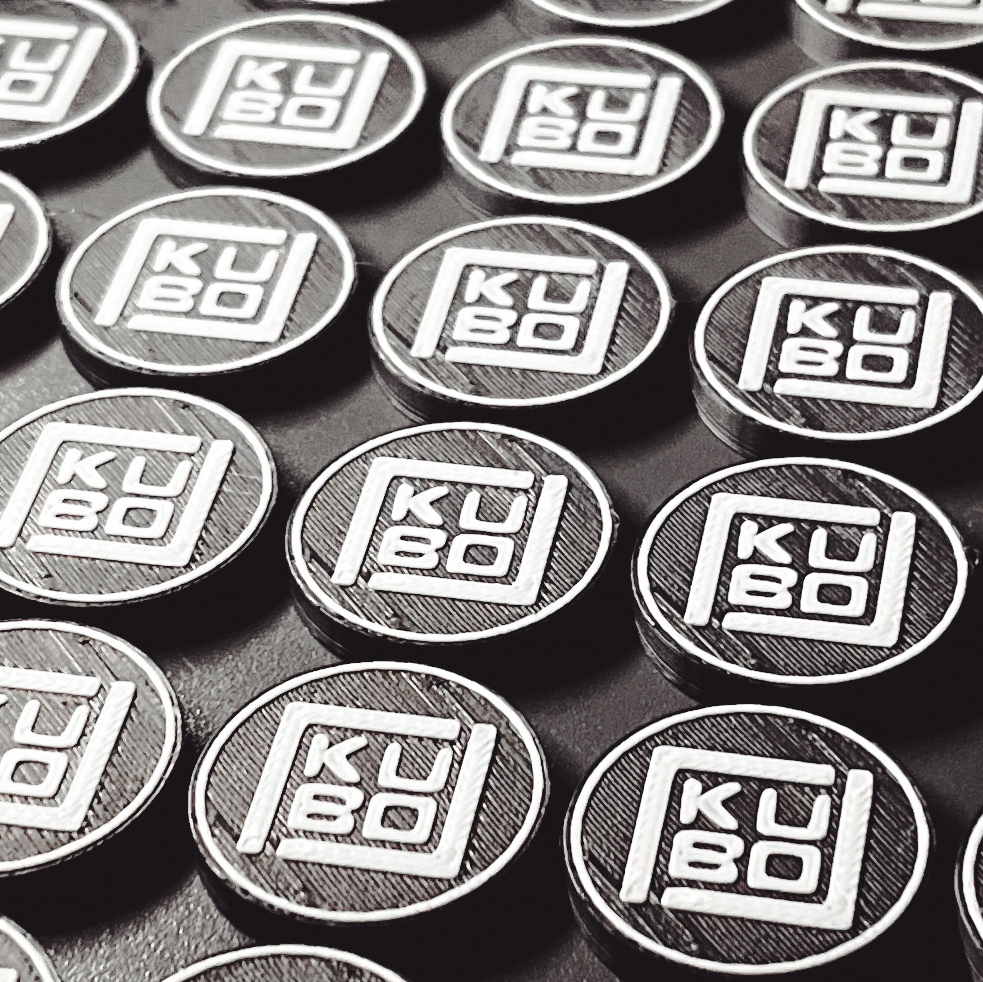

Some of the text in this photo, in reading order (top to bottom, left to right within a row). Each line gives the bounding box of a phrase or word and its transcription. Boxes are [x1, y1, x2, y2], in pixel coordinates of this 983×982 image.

[236, 59, 354, 97] KU
[222, 89, 341, 128] BO
[527, 83, 647, 123] KU
[516, 115, 638, 155] BO
[829, 108, 951, 148] KU
[822, 141, 945, 181] BO
[148, 236, 286, 283] KU
[131, 273, 265, 319] BO
[464, 267, 592, 313] KU
[450, 305, 581, 350] BO
[786, 298, 917, 344] KU
[778, 337, 909, 383] BO
[48, 446, 194, 497] KU
[29, 488, 175, 539] BO
[390, 477, 529, 534] KU
[369, 525, 515, 577] BO
[737, 517, 877, 572] KU
[727, 563, 869, 617] BO
[303, 733, 454, 792] KU
[277, 782, 437, 844] BO
[679, 777, 831, 840] KU
[668, 829, 821, 893] BO
